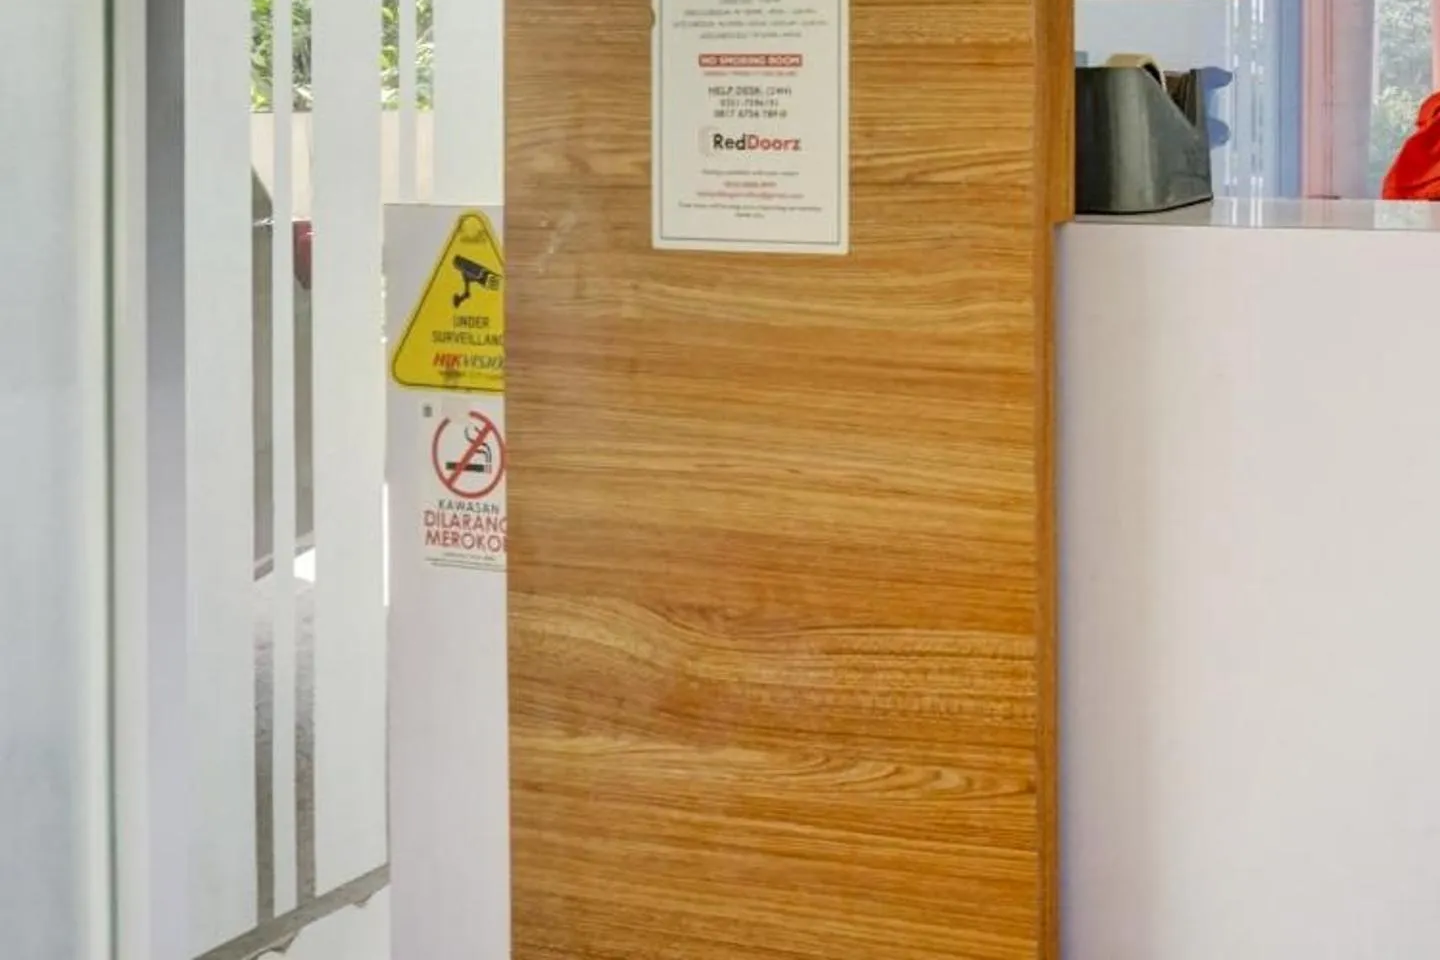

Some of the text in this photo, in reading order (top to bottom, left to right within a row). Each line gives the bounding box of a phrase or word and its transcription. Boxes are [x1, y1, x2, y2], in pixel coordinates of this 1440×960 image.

[713, 133, 800, 151] RedDoorz
[453, 315, 489, 329] UNDER
[438, 500, 499, 515] KAWASAN
[425, 529, 508, 552] MEROKO
